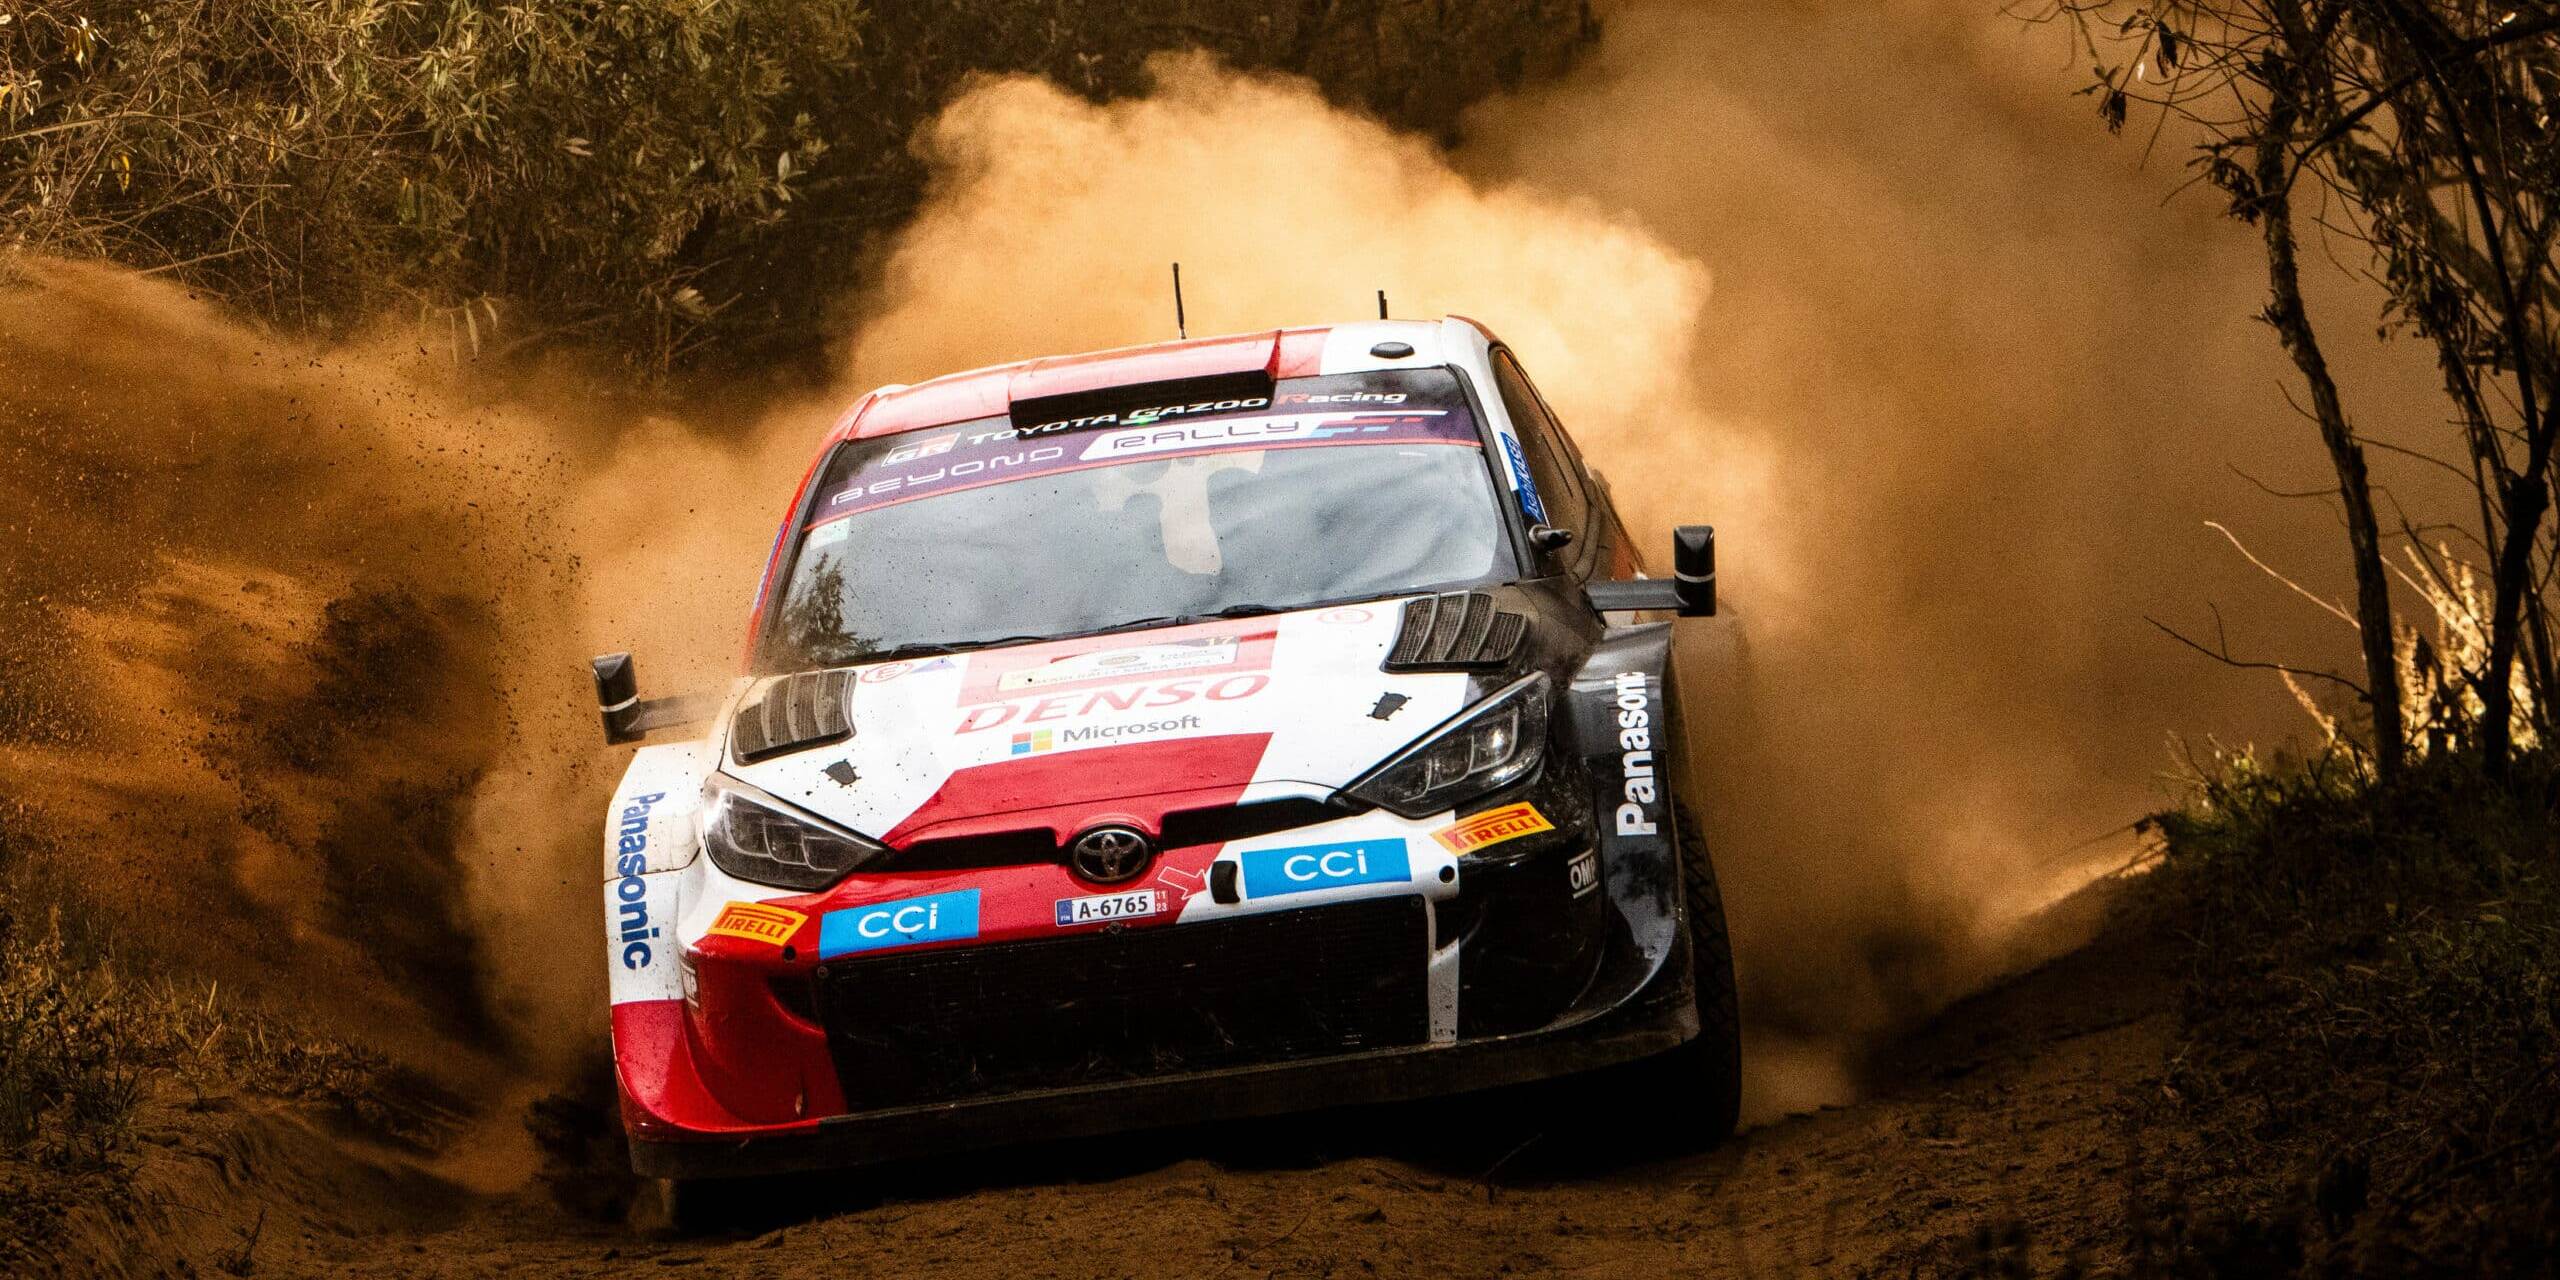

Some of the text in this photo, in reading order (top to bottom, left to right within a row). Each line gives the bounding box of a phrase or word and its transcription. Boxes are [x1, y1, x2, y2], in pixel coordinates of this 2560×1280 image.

[967, 414, 1117, 445] TOYOTA
[1128, 398, 1268, 421] GAZOO
[1277, 392, 1406, 405] Racing
[832, 421, 1299, 506] BEYOND RALLY
[954, 675, 1270, 734] DENSO
[1063, 715, 1200, 742] Microsoft
[1446, 809, 1540, 849] PIRELLI
[618, 792, 666, 970] Panasonic
[1570, 855, 1596, 890] OMP
[716, 906, 797, 939] PIRELLI
[1079, 896, 1148, 919] A-6765
